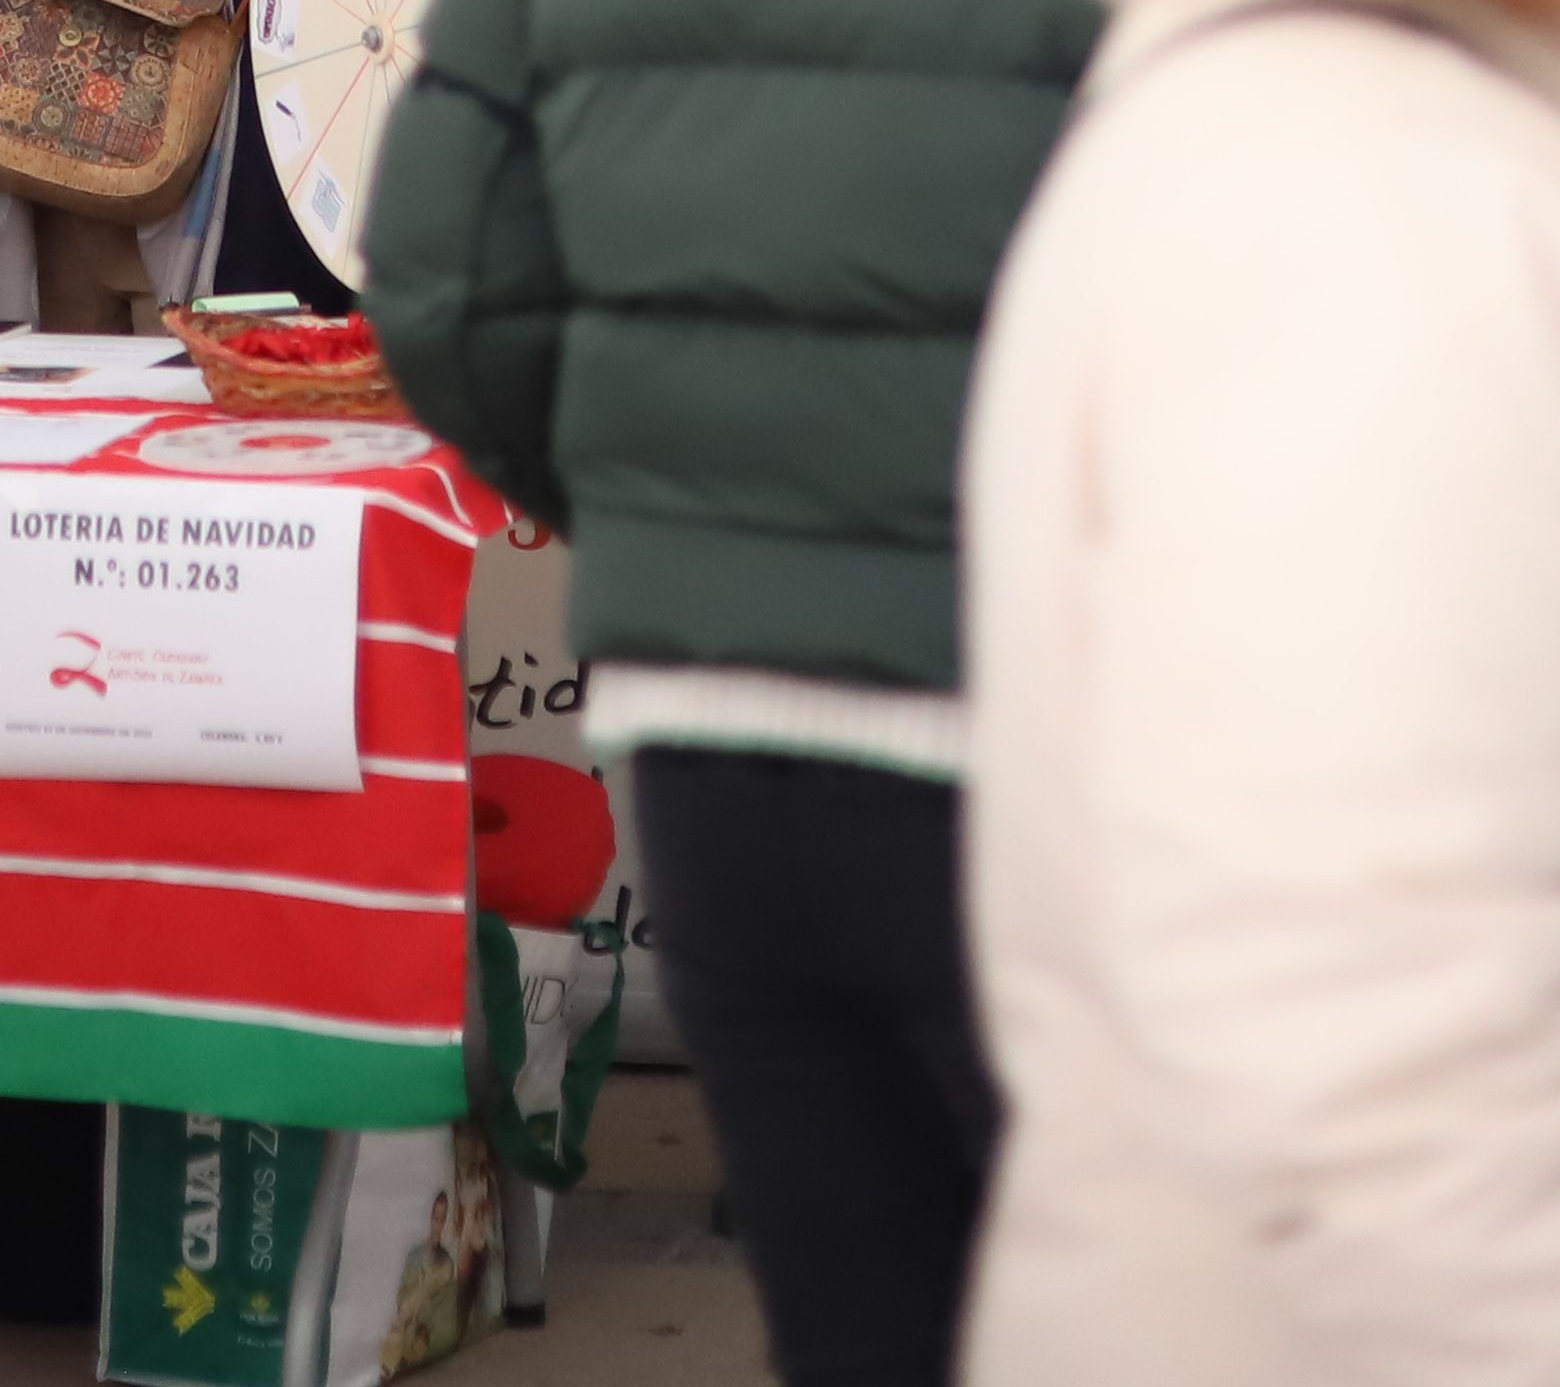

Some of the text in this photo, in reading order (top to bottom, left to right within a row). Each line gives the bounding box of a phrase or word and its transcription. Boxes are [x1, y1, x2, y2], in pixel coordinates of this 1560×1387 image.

[10, 513, 316, 550] LOTERIA DE NAVIDAD
[138, 561, 240, 592] 01.263
[182, 1155, 219, 1271] CAJA
[251, 1169, 276, 1271] SOMOS
